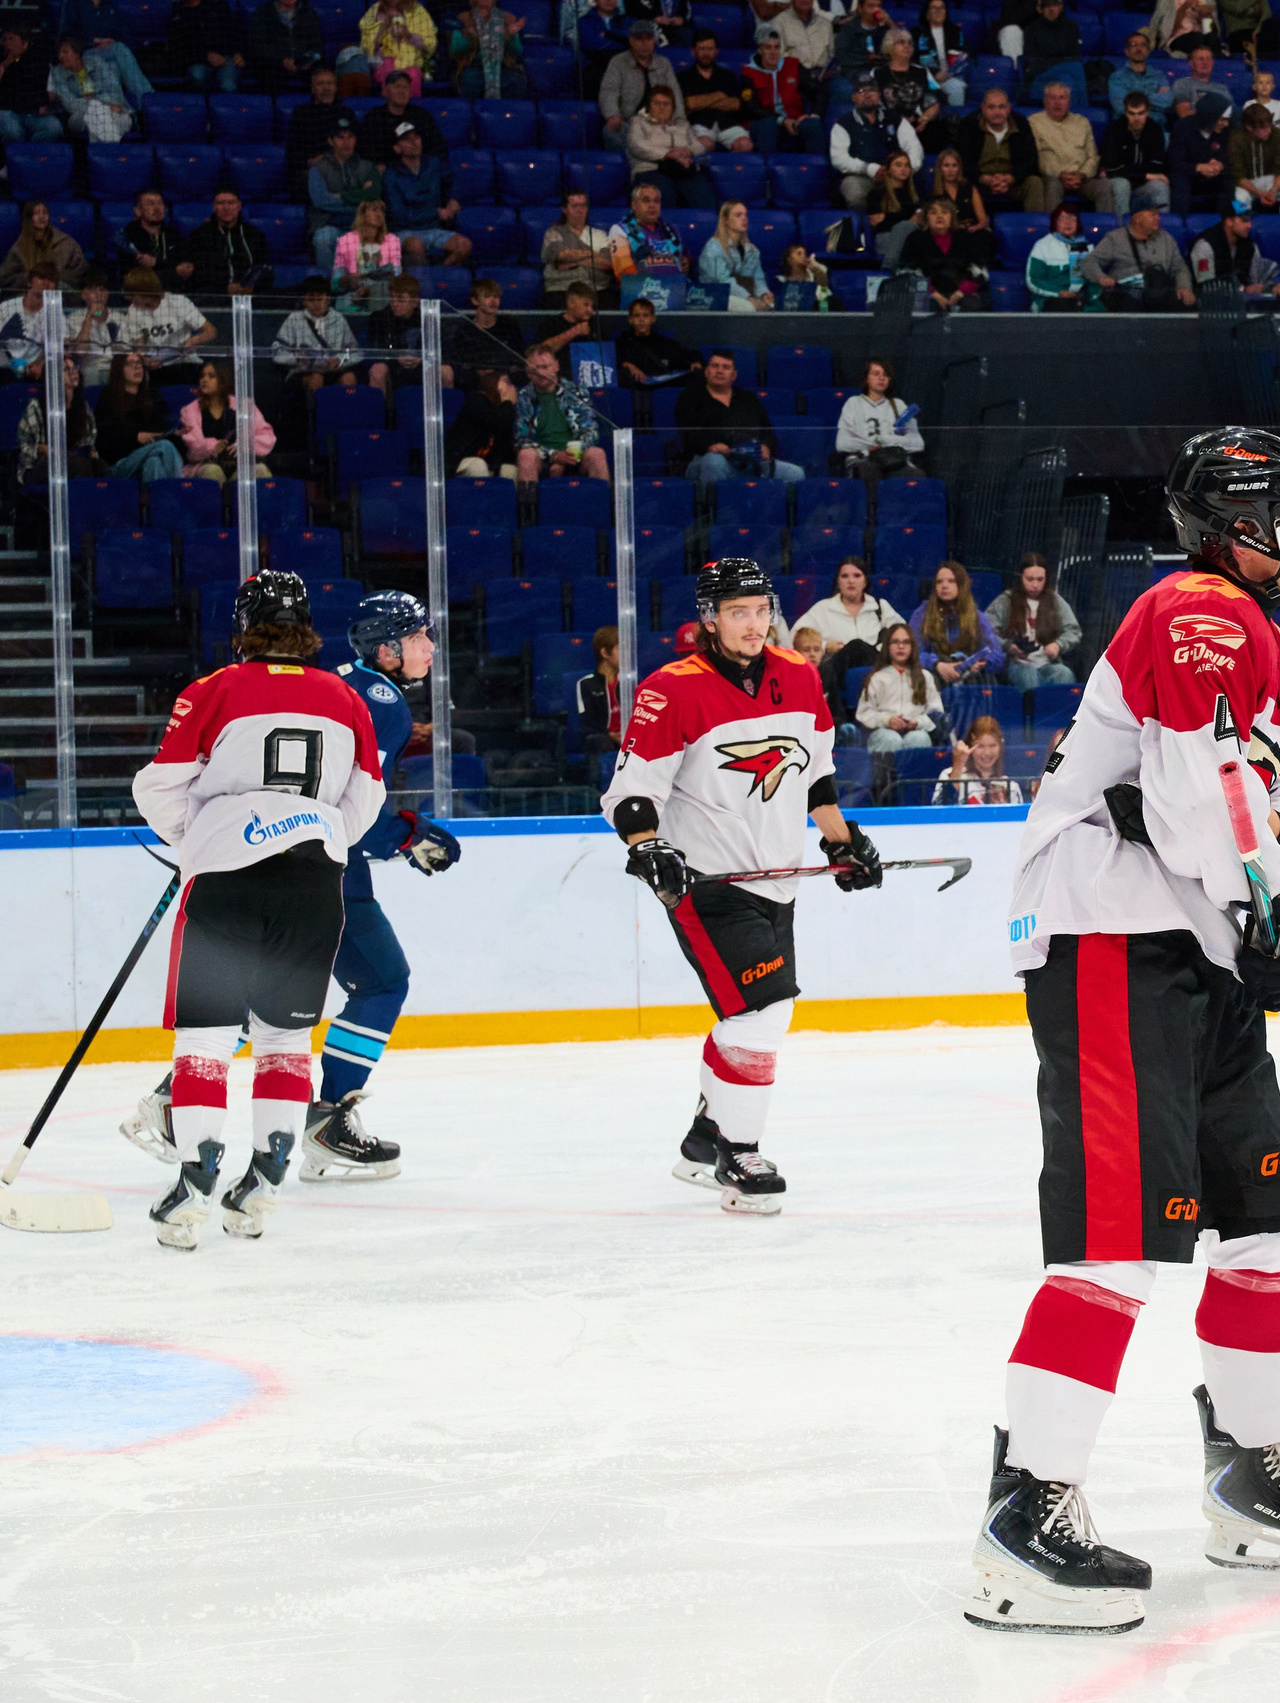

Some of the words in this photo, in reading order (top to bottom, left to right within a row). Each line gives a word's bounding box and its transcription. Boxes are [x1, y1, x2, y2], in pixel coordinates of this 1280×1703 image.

[740, 579, 763, 587] CCM
[769, 677, 783, 705] C
[263, 727, 323, 800] 9
[1026, 1540, 1067, 1566] BAUER
